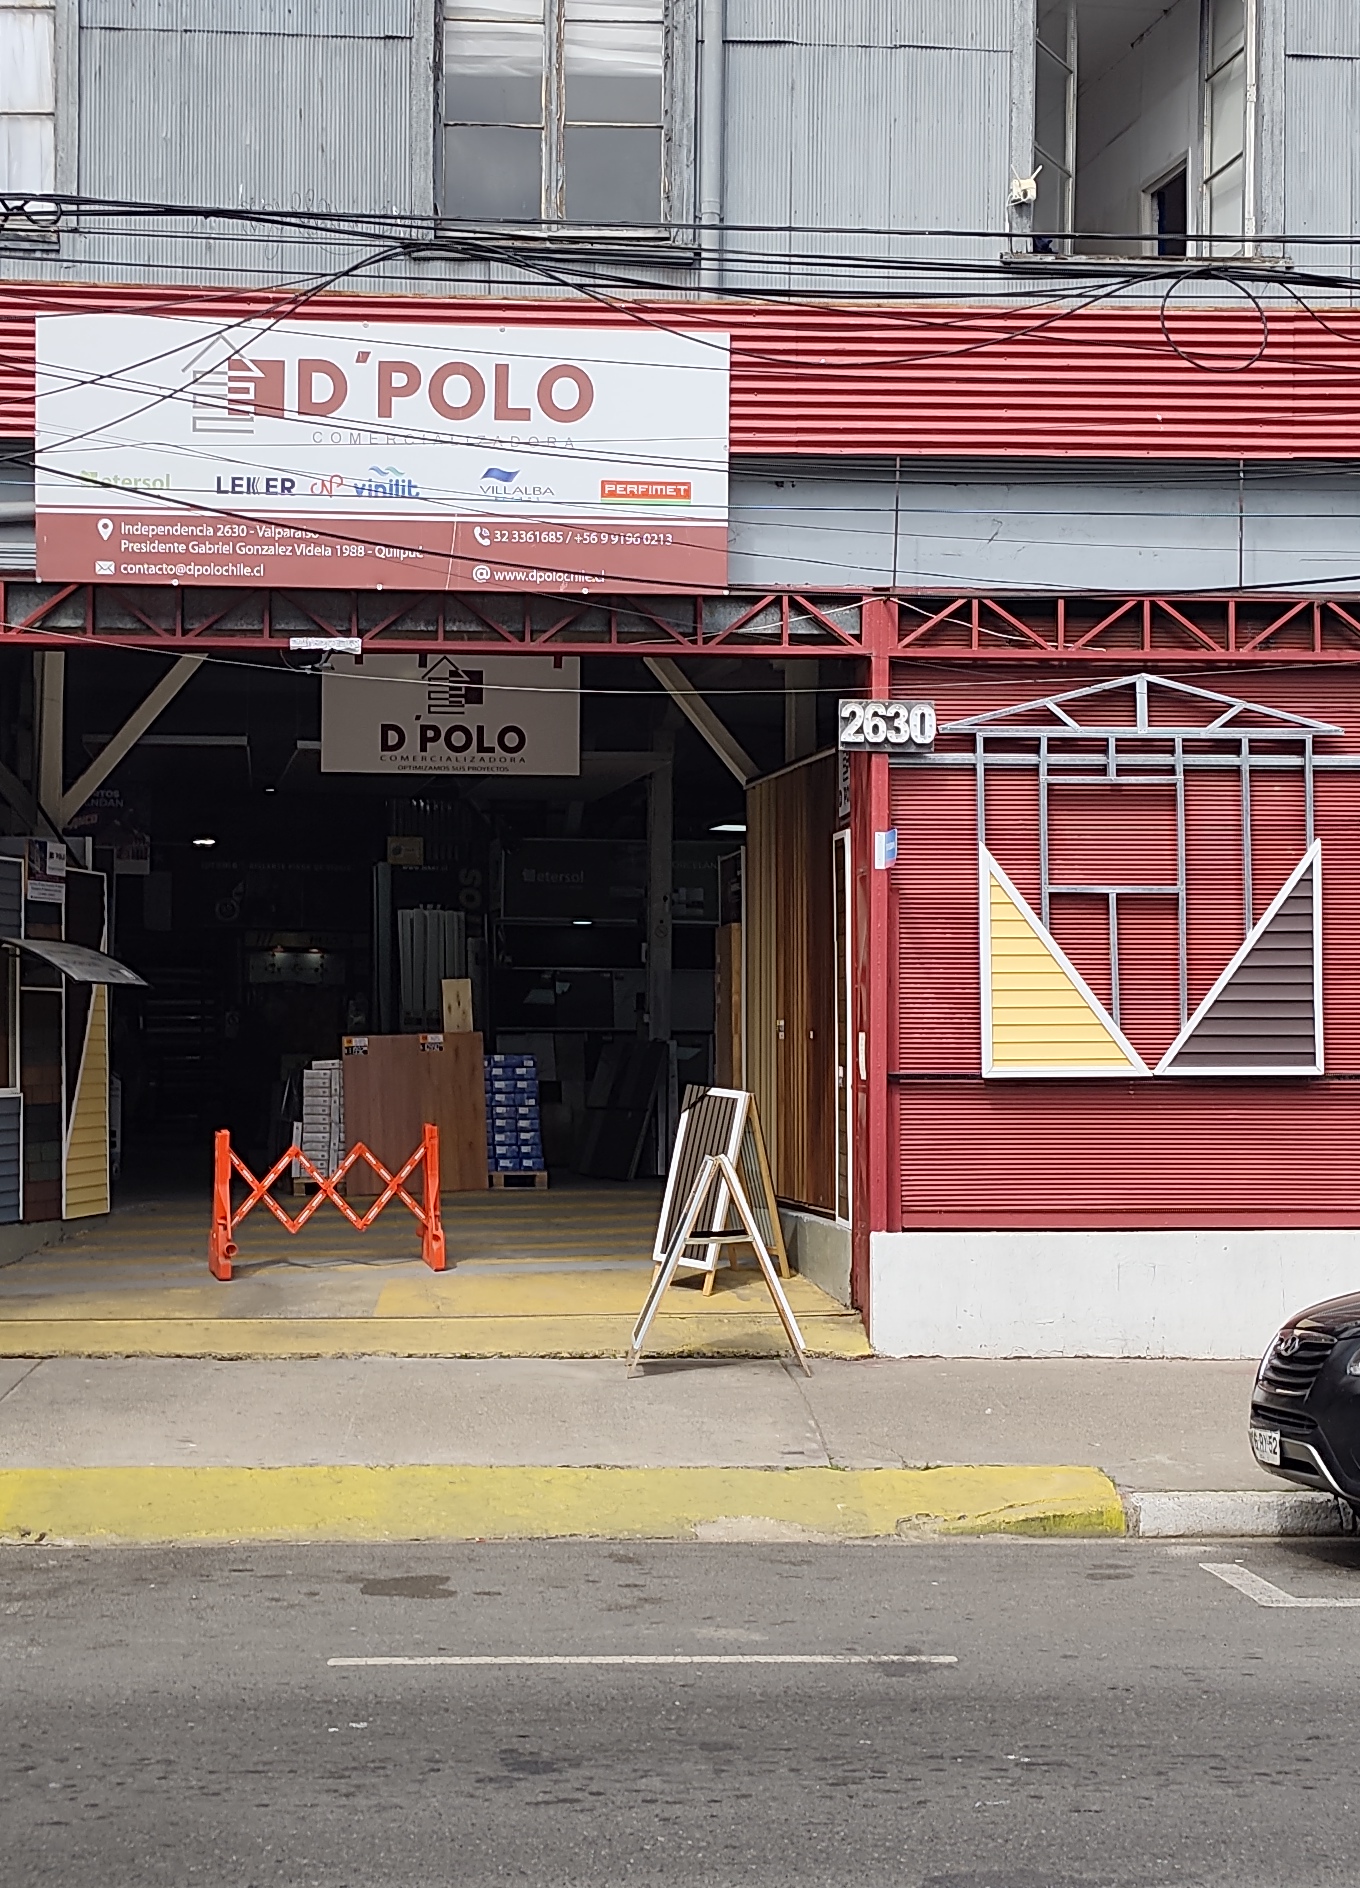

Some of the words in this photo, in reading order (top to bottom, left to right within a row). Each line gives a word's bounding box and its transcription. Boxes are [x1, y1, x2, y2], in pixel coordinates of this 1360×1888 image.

[479, 485, 555, 496] VILLALBA
[604, 484, 689, 496] PERFIMET
[120, 522, 214, 538] Independencia
[217, 525, 247, 538] 2630
[494, 530, 509, 542] 32
[512, 531, 564, 543] 3361685
[574, 532, 598, 544] +56
[642, 534, 673, 546] 0213
[120, 540, 187, 554] Presidente
[189, 541, 233, 554] Gabriel
[236, 543, 293, 556] Gonzalez
[294, 543, 332, 556] Videla
[335, 545, 365, 557] 1988
[120, 561, 265, 577] contacto@dpolochile.cl
[841, 702, 937, 744] 2630
[380, 755, 526, 764] COMERCIALIZADORA
